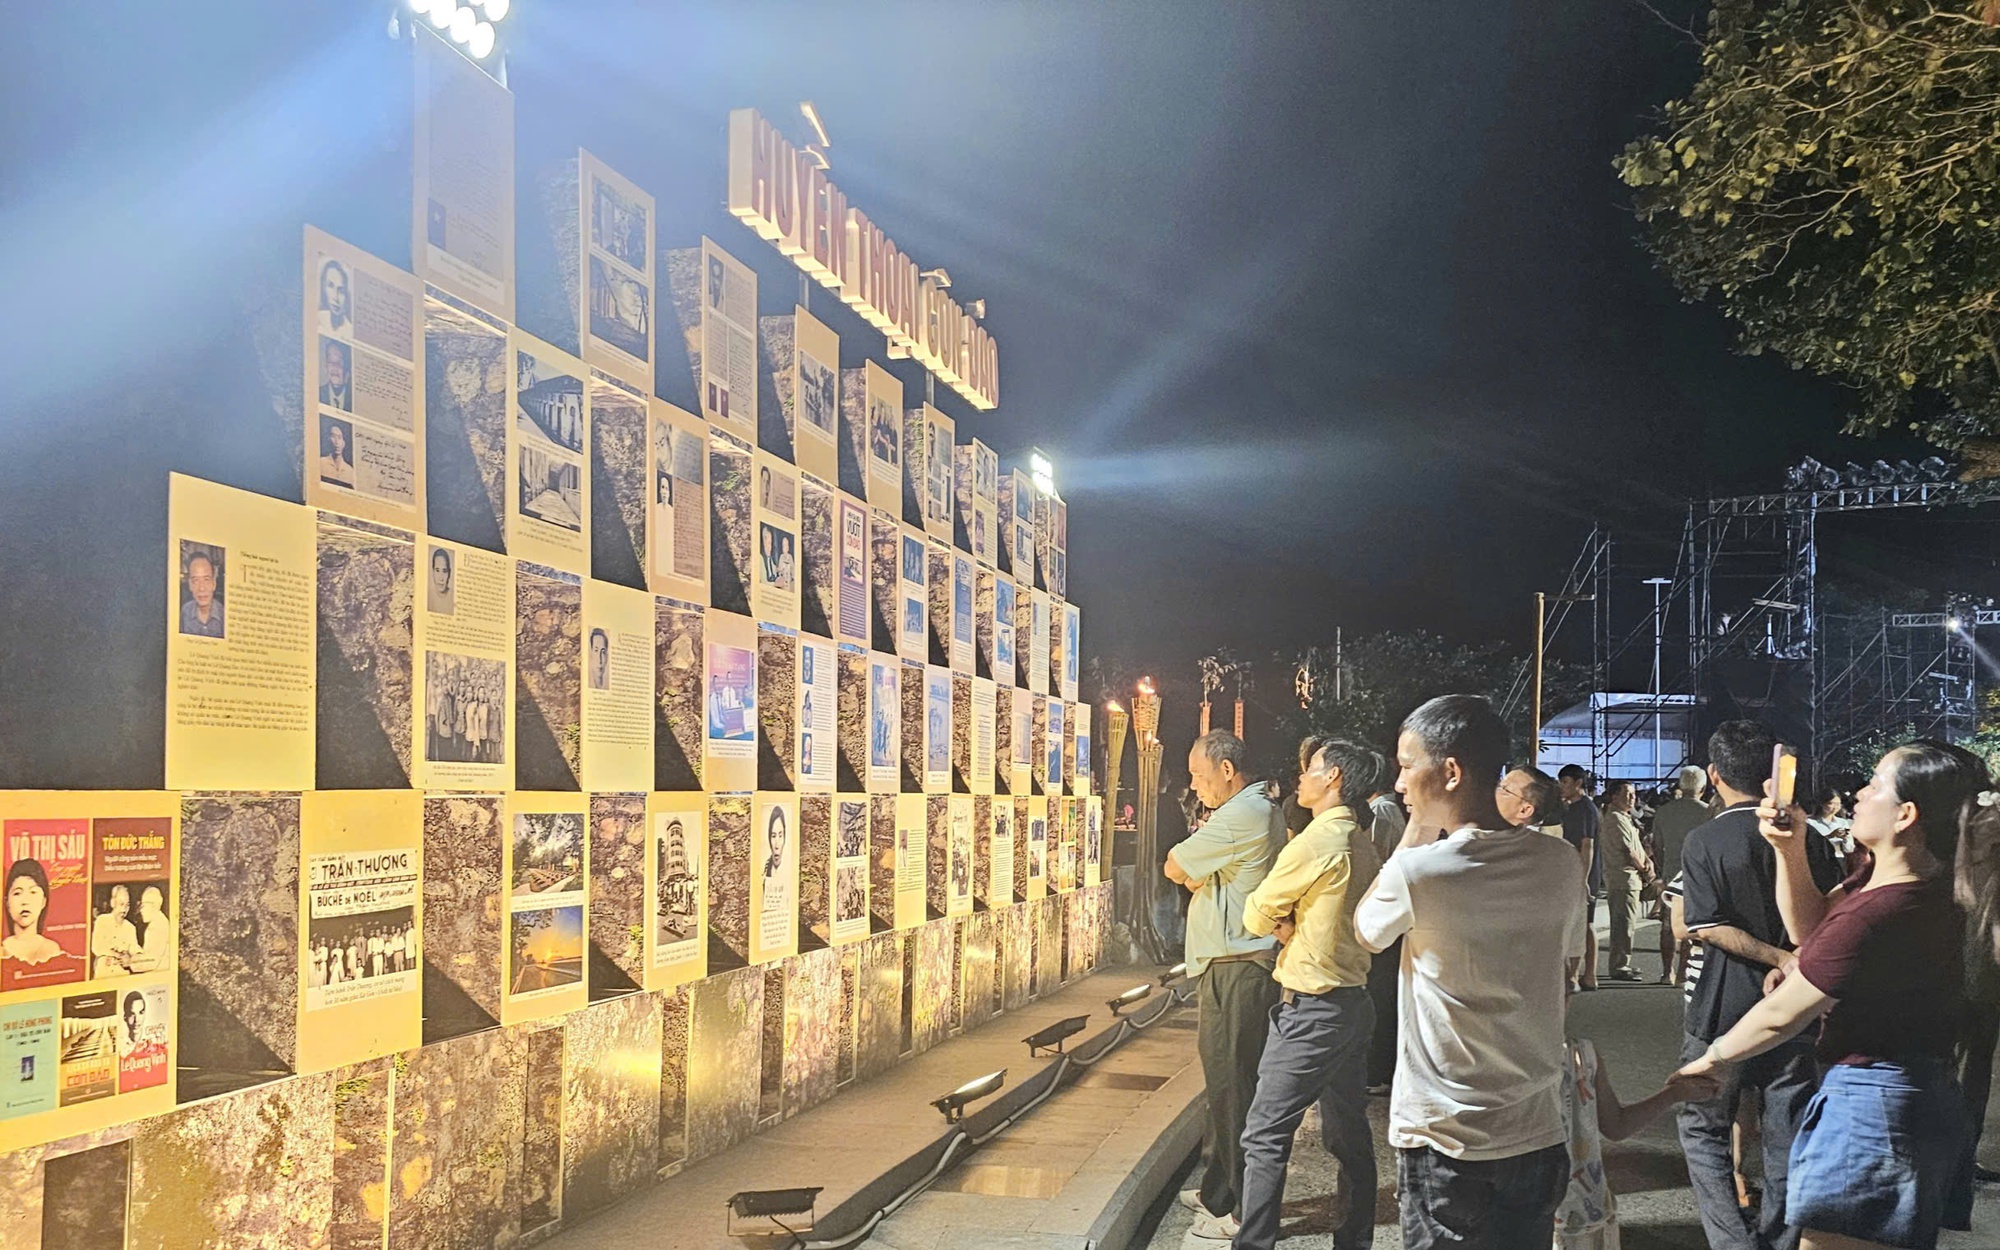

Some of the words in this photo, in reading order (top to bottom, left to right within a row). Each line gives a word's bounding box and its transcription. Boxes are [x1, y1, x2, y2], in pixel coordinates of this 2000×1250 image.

[10, 832, 30, 861] VÕ
[32, 834, 56, 865] THỊ
[58, 829, 86, 860] SÁU
[102, 833, 120, 850] TÔN
[121, 833, 137, 850] ĐỨC
[138, 830, 165, 850] THẮNG
[358, 853, 407, 875] THƯỢNG
